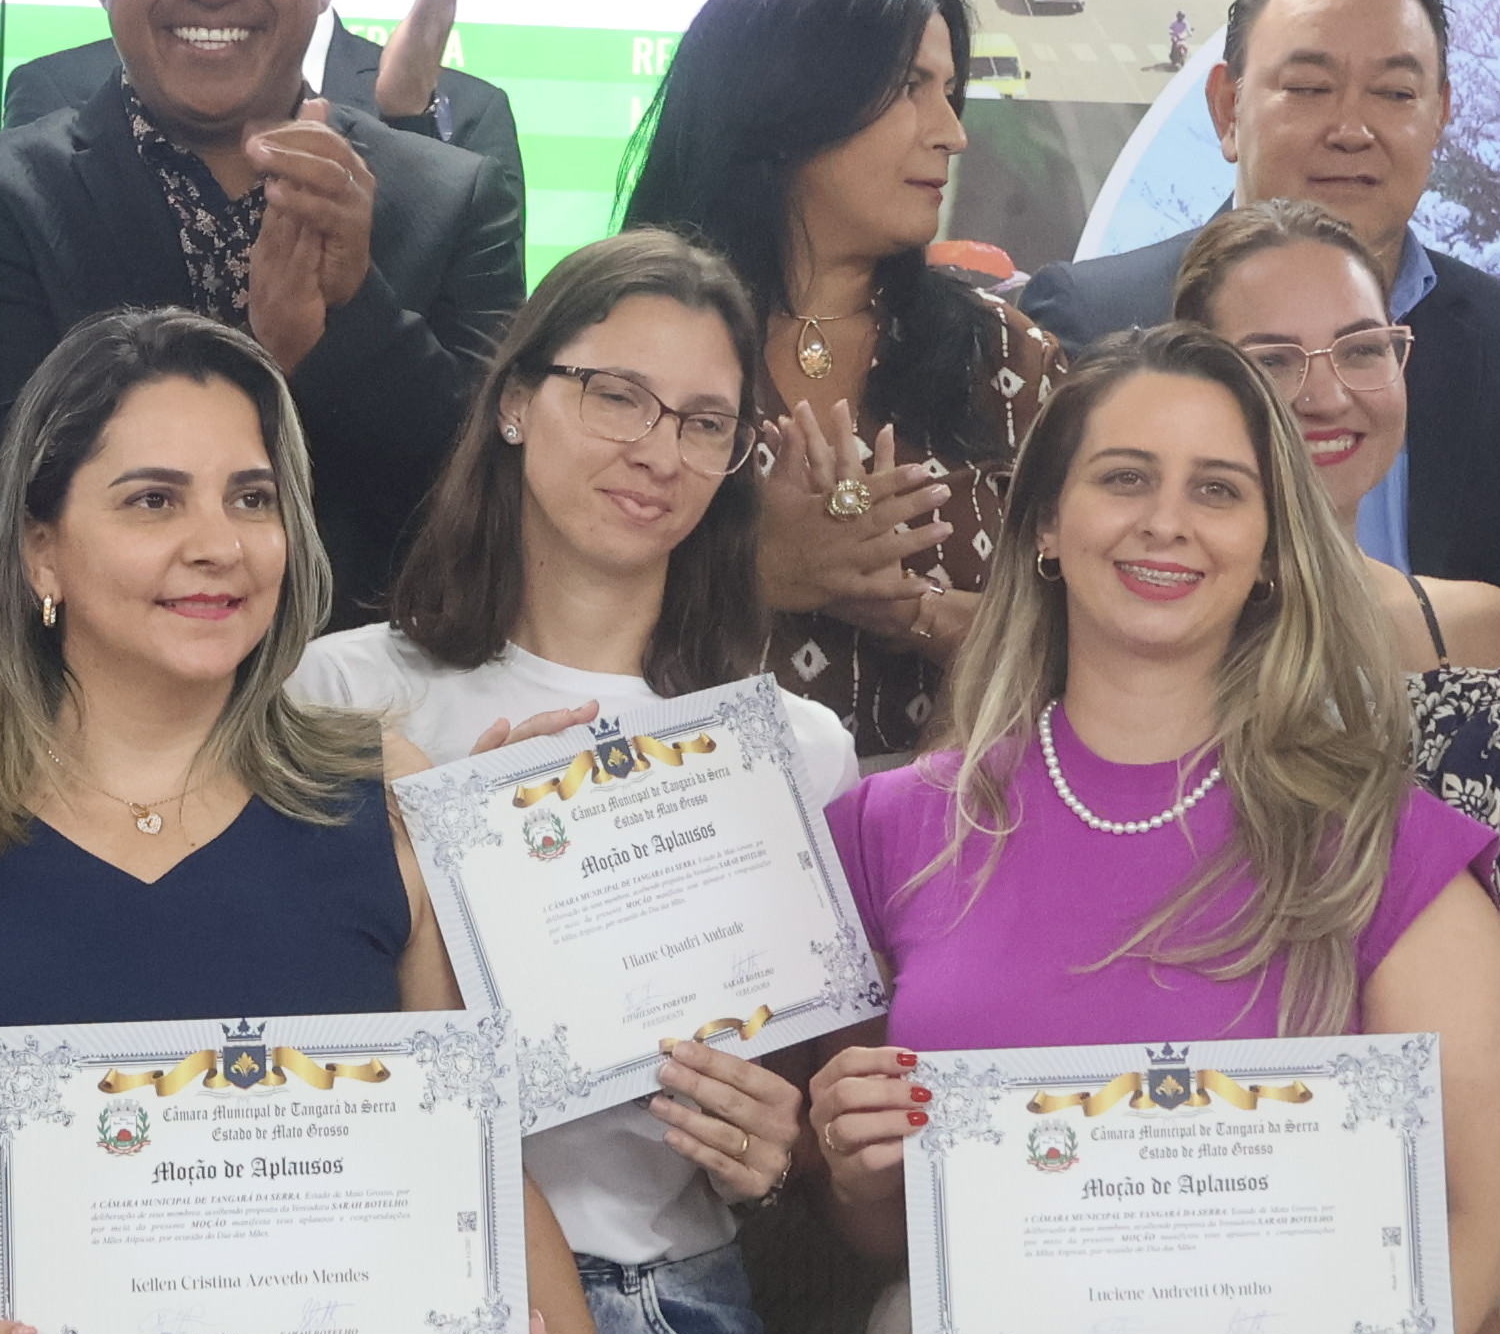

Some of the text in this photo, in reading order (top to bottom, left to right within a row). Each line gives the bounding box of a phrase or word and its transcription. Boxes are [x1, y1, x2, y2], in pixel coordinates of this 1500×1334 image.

[580, 821, 717, 879] Moção de Aplausos
[659, 934, 701, 959] Quadri
[702, 920, 745, 944] Andrade
[162, 1099, 397, 1123] Câmara Municipal de Tangará da Serra
[211, 1122, 349, 1142] Estado de Mato Grosso
[151, 1156, 344, 1186] Moção de Aplausos
[1081, 1174, 1269, 1202] Moção de Aplausos
[131, 1267, 370, 1293] Kellen Cristina Azevedo Mendes
[1088, 1287, 1145, 1302] Luciene
